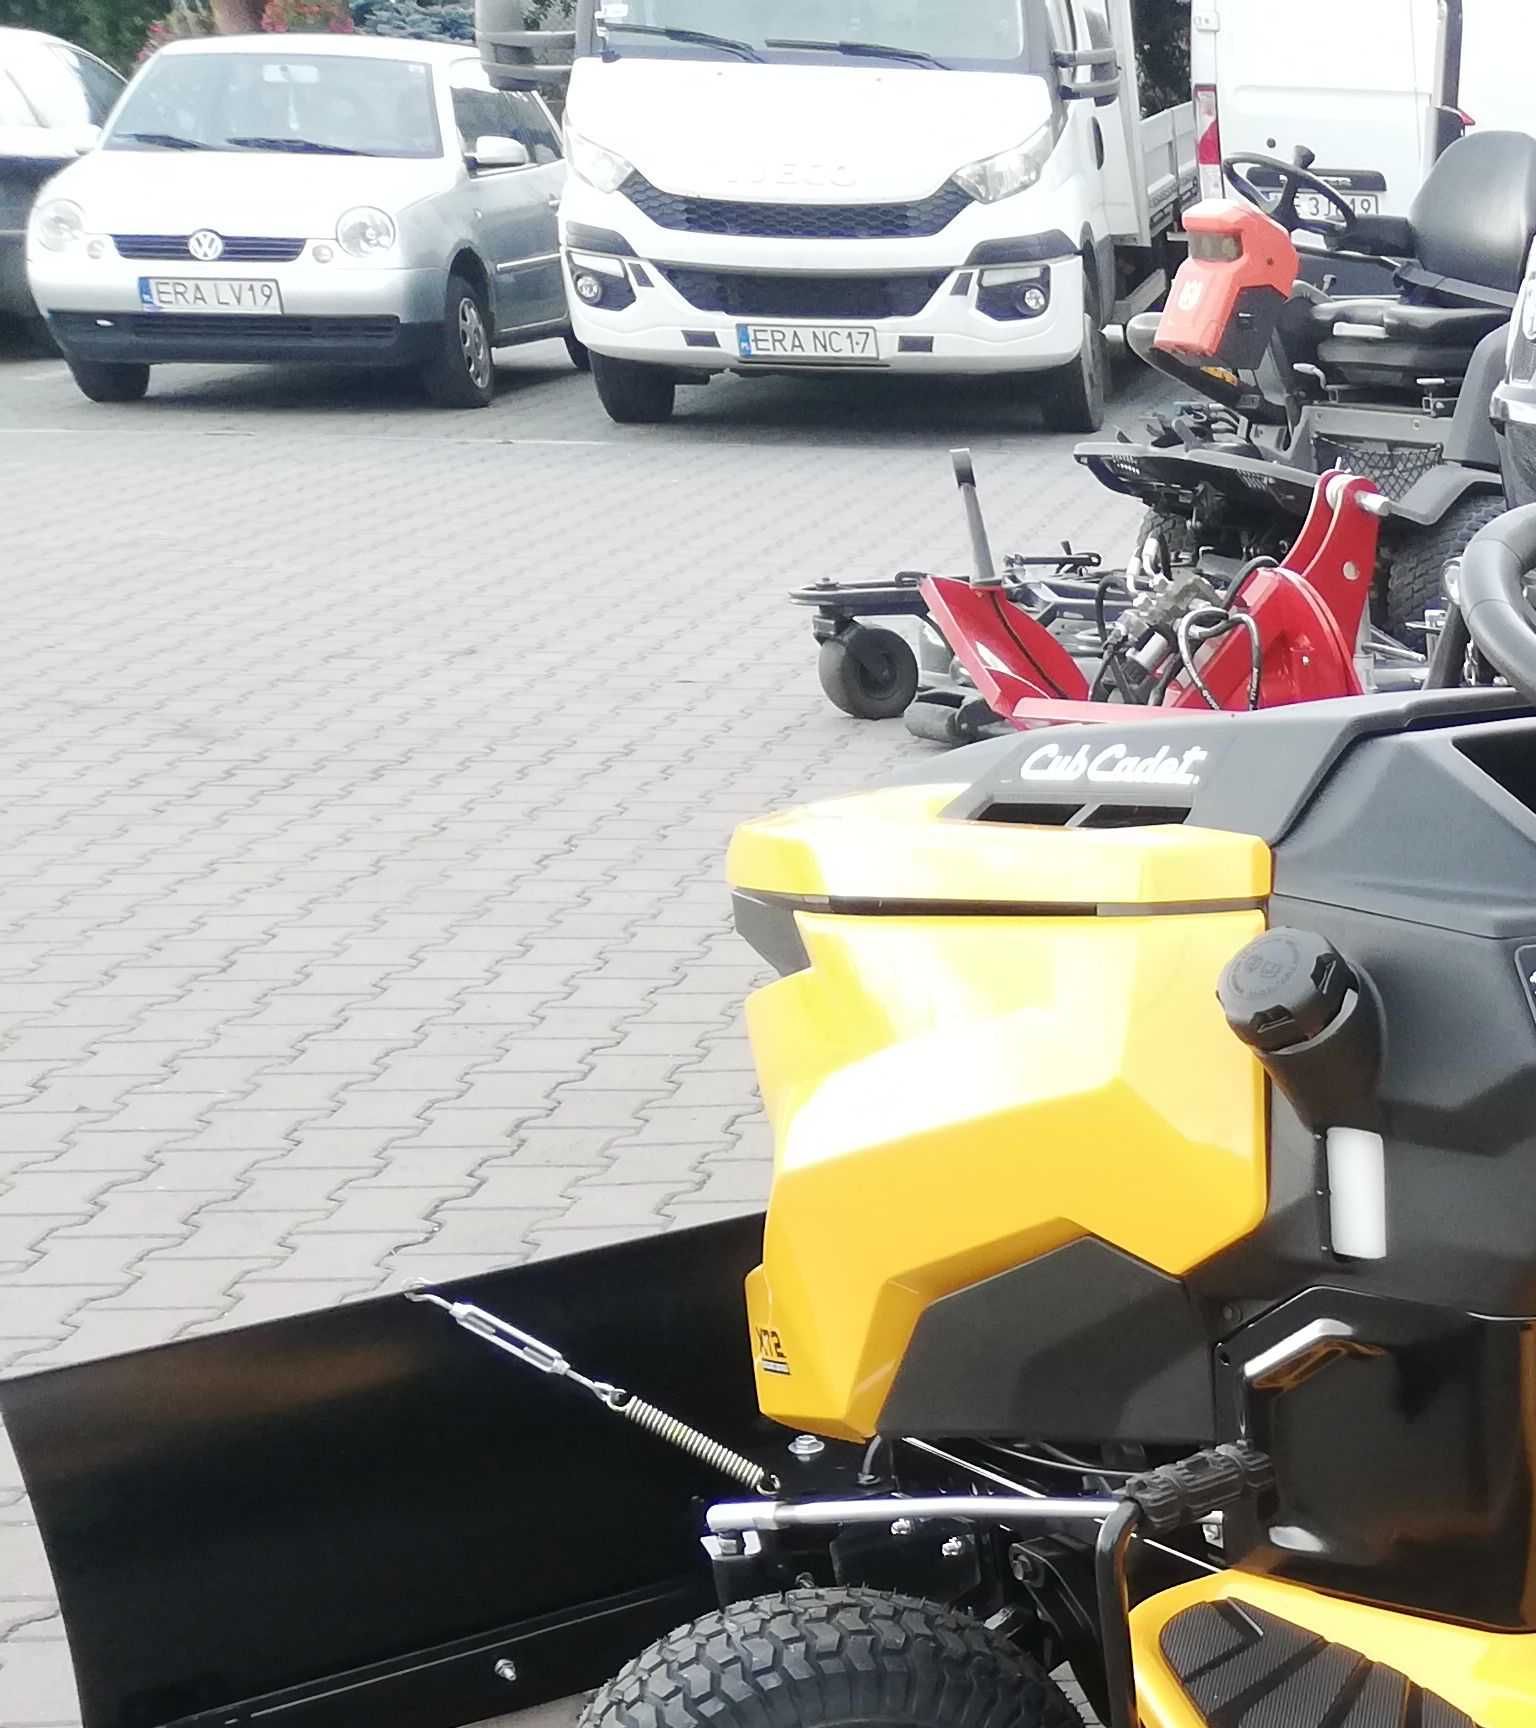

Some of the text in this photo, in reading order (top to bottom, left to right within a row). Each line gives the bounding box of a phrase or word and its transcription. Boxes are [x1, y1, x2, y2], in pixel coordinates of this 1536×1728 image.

[154, 281, 274, 306] ERA LV19
[752, 328, 871, 354] ERA NC17
[1020, 743, 1091, 781] Cub
